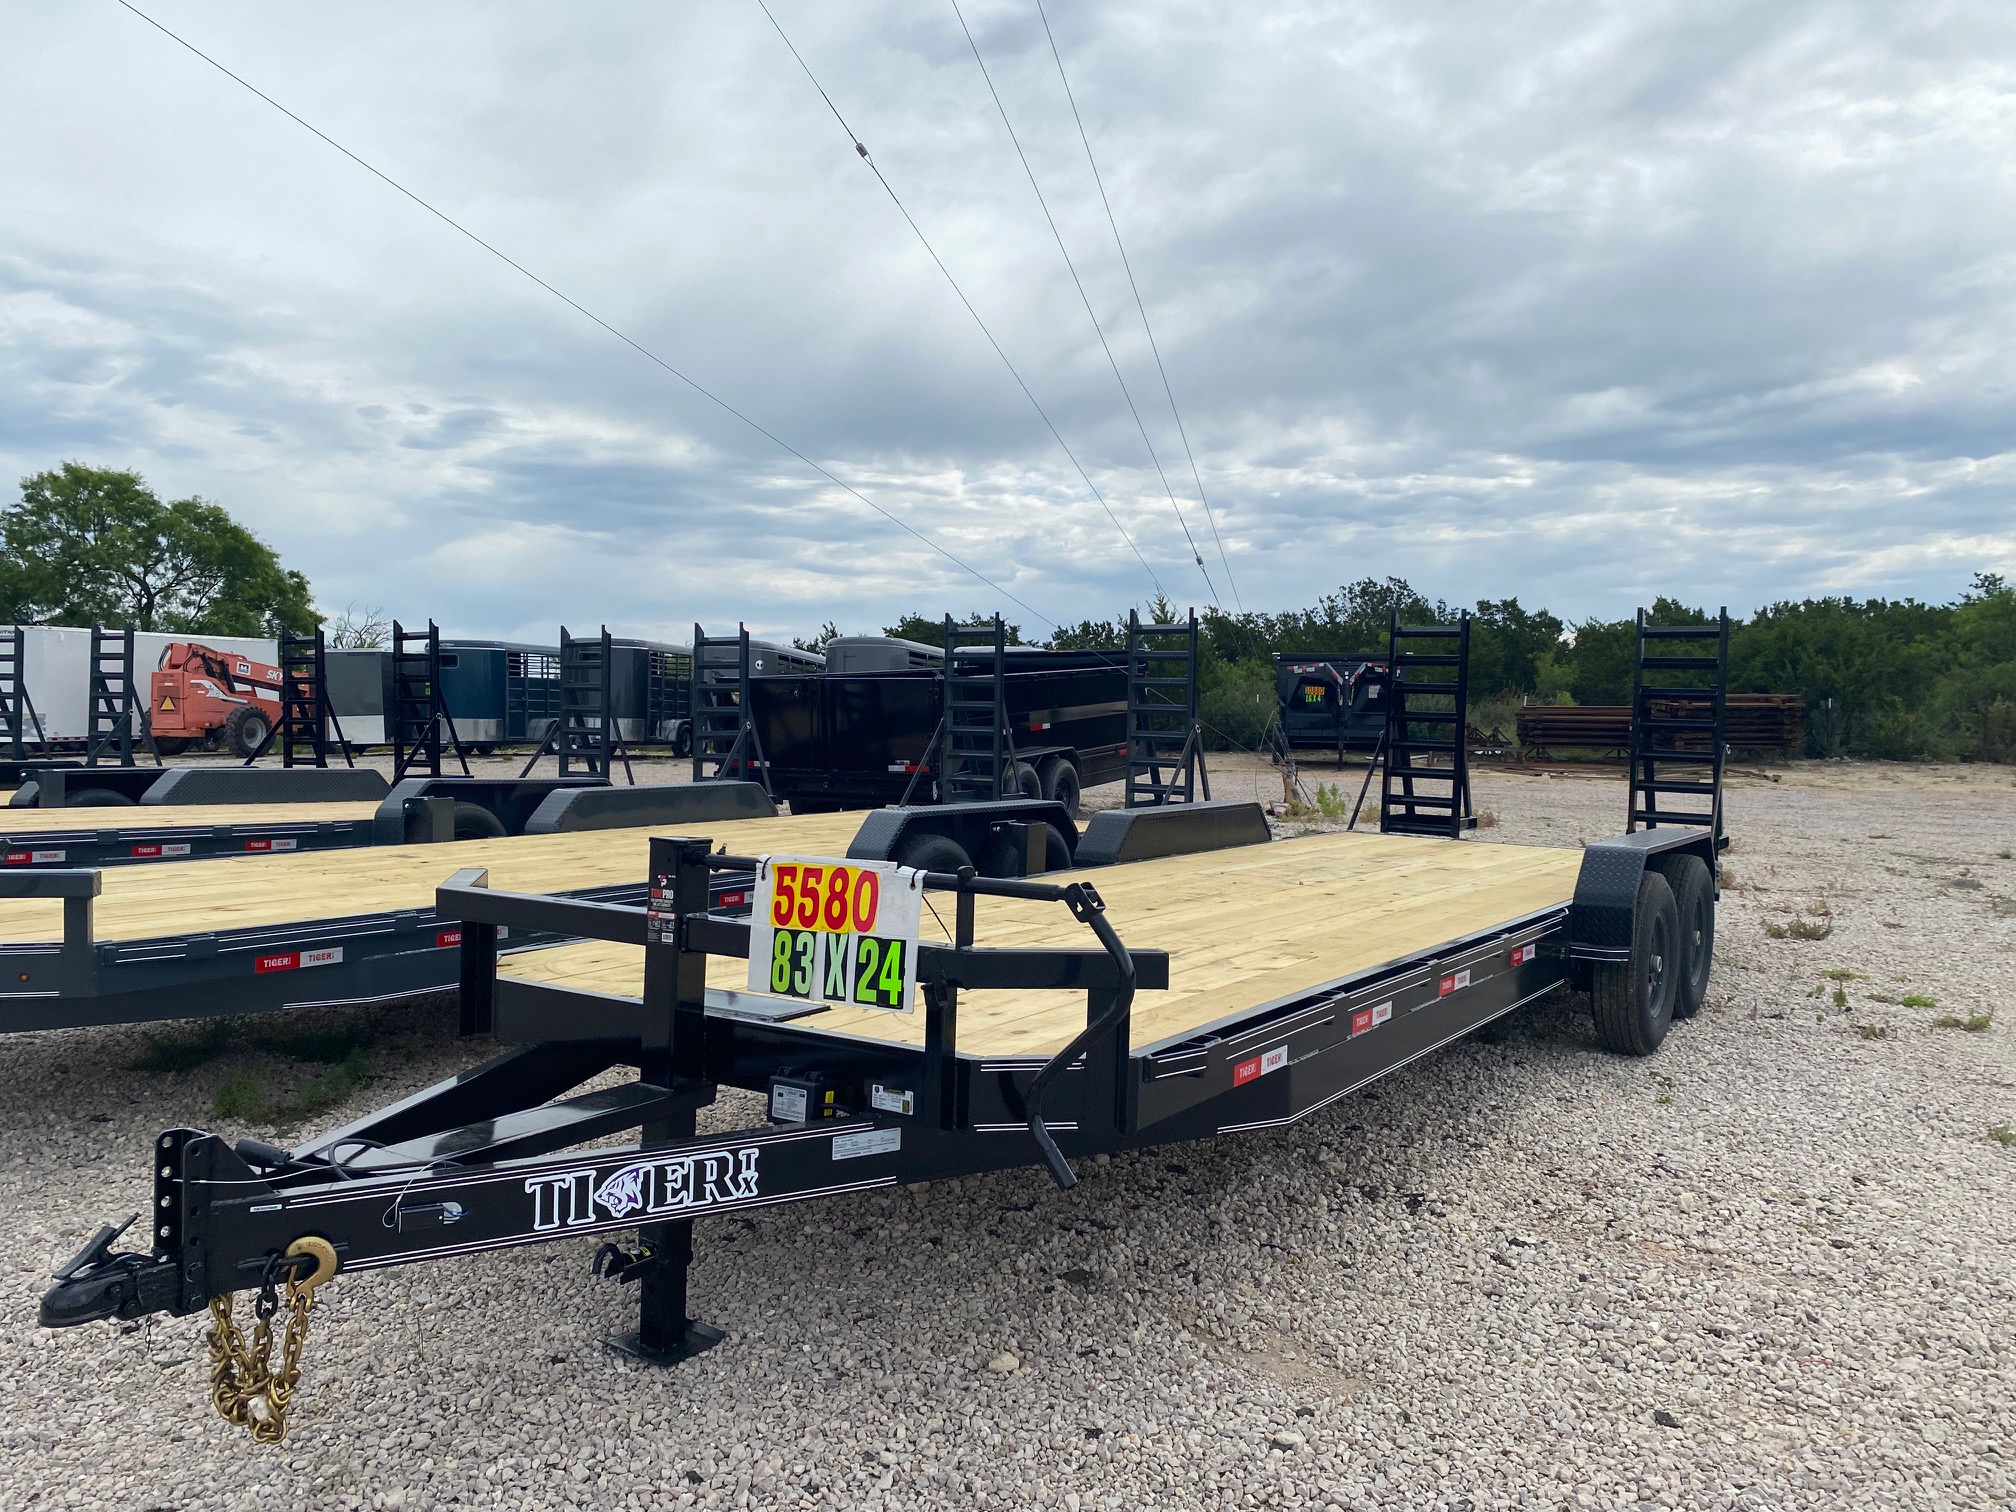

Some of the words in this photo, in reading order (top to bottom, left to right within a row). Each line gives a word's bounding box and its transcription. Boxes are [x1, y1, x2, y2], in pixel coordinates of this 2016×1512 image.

[773, 866, 879, 932] 5580
[443, 933, 462, 943] TIGE
[263, 957, 292, 968] TIGER
[307, 952, 334, 963] TIGER
[771, 930, 815, 995] 83
[856, 938, 902, 1006] 24
[1239, 1062, 1257, 1078] TIGER
[1266, 1052, 1283, 1067] TIGER
